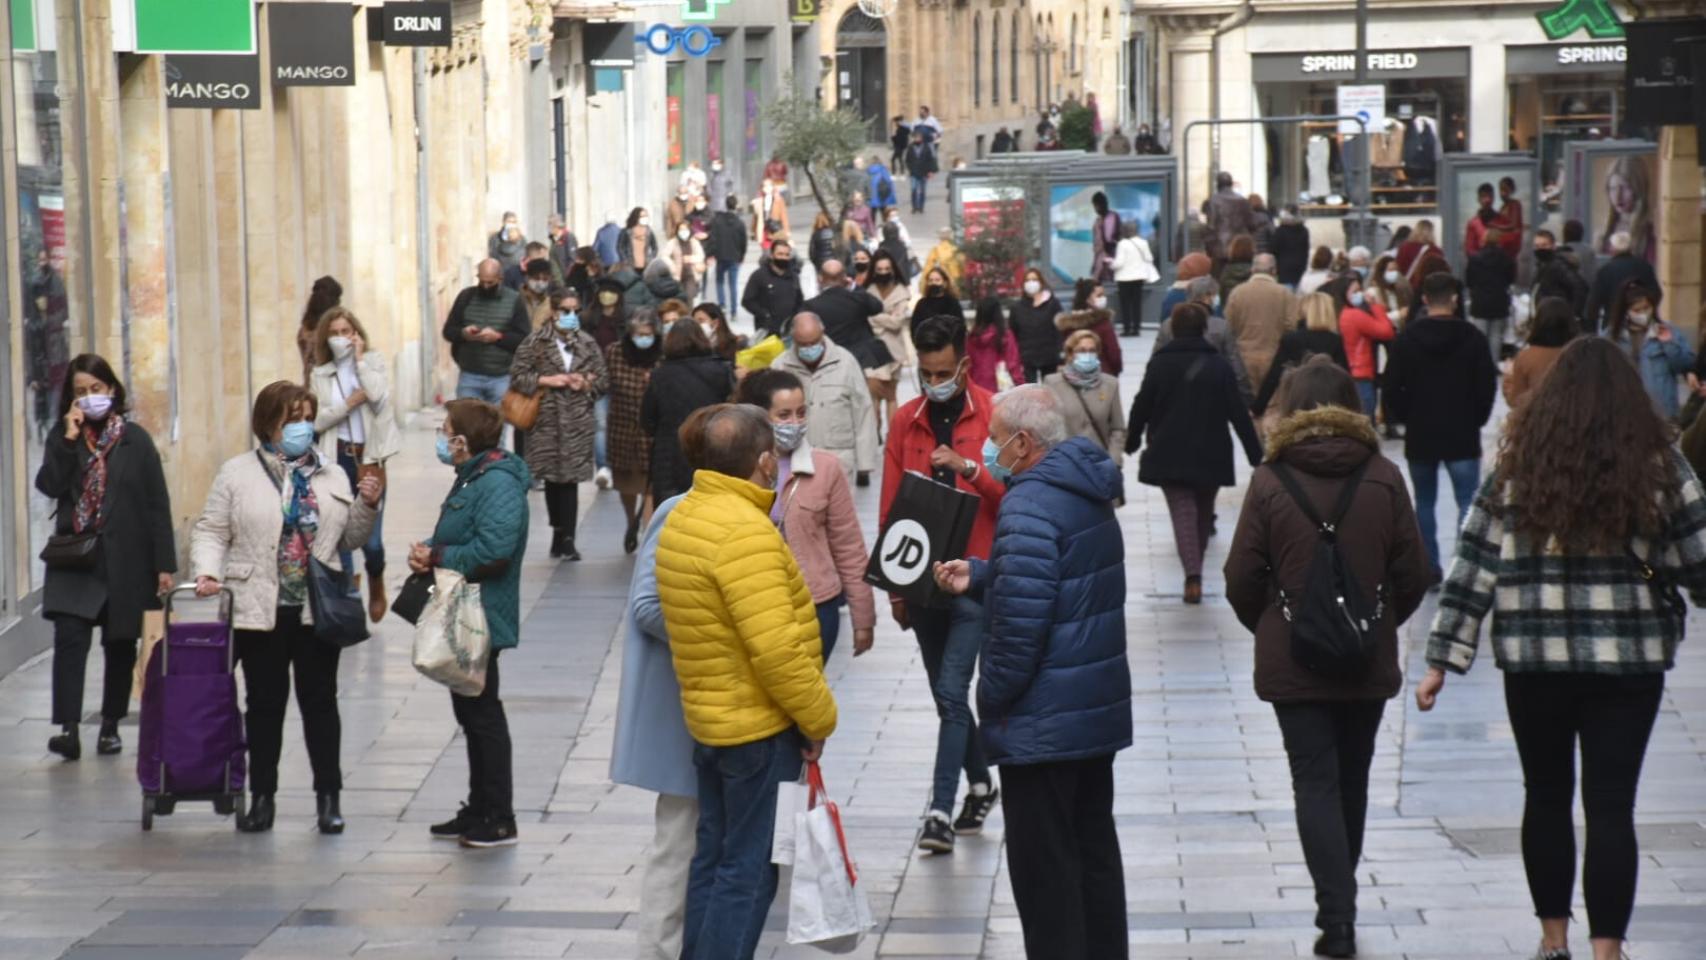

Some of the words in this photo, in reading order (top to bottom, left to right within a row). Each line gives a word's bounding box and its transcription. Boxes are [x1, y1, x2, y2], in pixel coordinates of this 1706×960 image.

[394, 16, 442, 31] DRUNI
[1302, 53, 1418, 72] SPRINFIELD
[277, 66, 348, 79] MANGO
[165, 82, 250, 99] MANGO
[885, 534, 924, 569] JD
